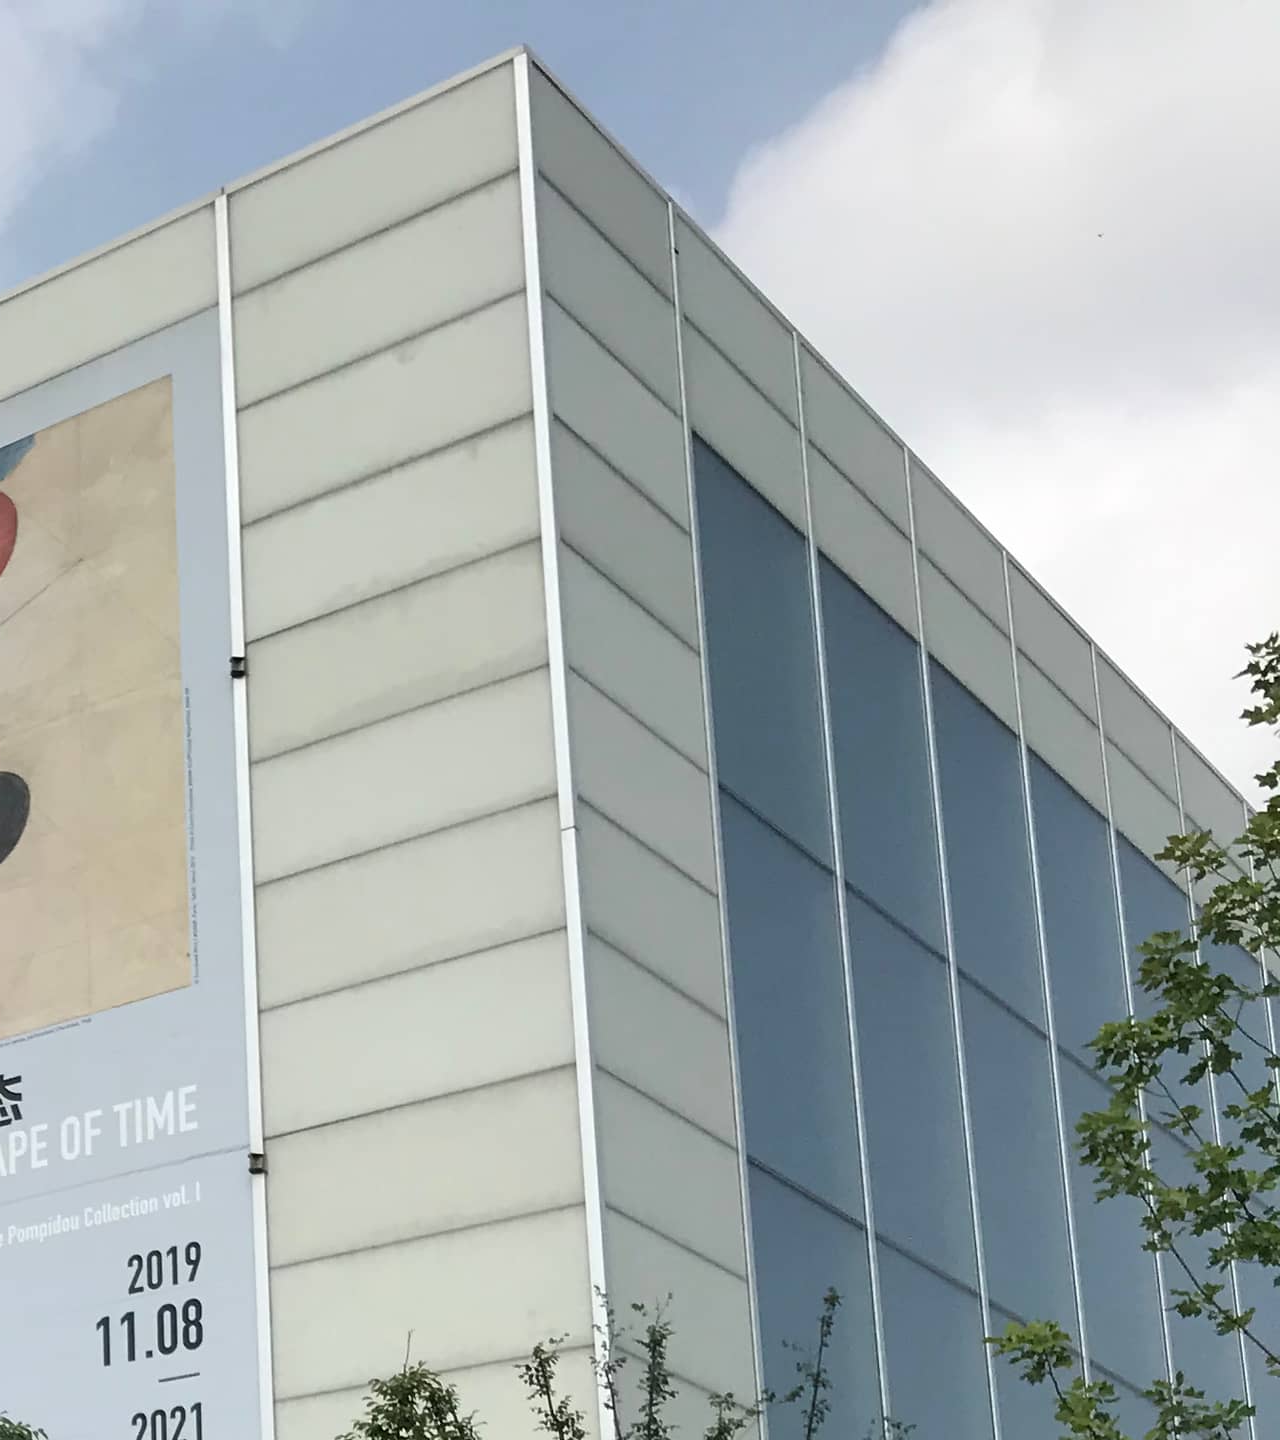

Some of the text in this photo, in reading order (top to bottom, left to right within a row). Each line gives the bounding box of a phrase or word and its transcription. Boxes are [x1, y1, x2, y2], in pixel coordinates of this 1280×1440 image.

[60, 1109, 104, 1162] OF
[112, 1084, 199, 1148] TIME
[7, 1214, 80, 1245] Pompidou
[83, 1196, 159, 1228] Collection
[162, 1184, 190, 1209] vol.
[127, 1241, 202, 1295] 2019
[96, 1297, 204, 1367] 11.08
